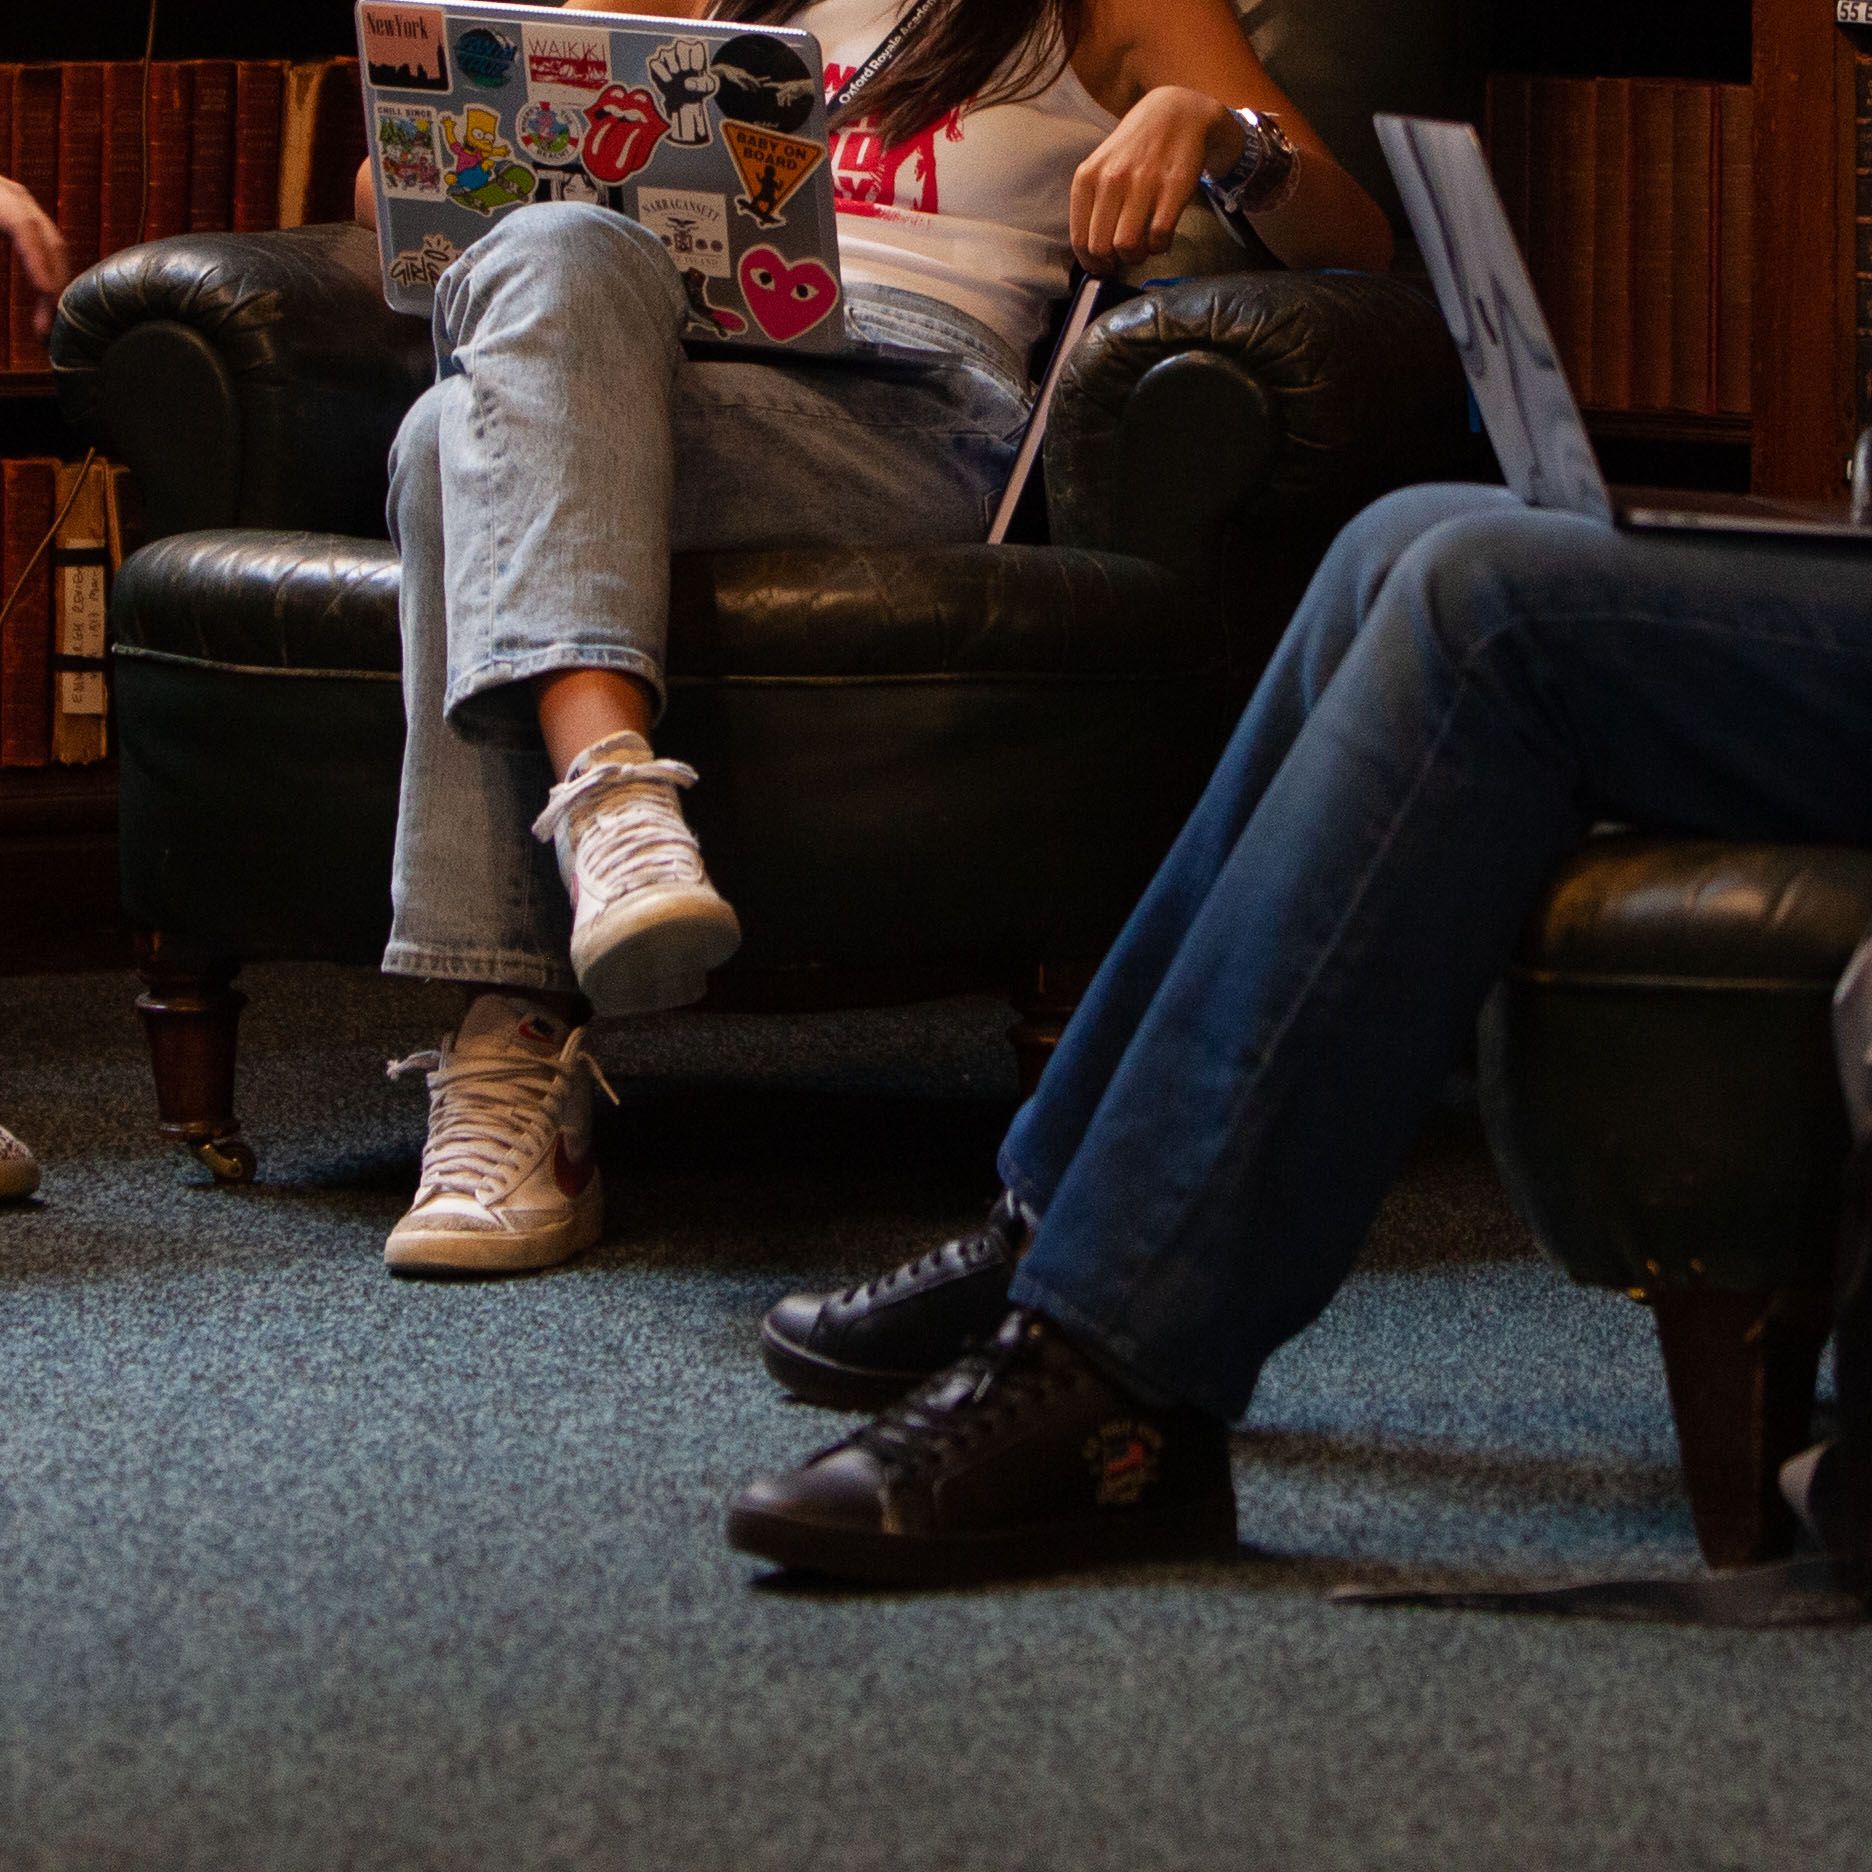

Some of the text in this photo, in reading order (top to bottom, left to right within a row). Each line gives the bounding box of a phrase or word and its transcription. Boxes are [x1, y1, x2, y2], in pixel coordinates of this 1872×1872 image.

[1839, 2, 1858, 21] 55
[530, 39, 607, 56] WAIKIKI
[838, 65, 872, 107] Oxford
[869, 34, 903, 69] Royale
[378, 106, 432, 118] CHILL SINCE
[736, 132, 807, 160] BABY ON
[743, 147, 798, 171] BOARD
[641, 198, 721, 222] NARRAGANSETT
